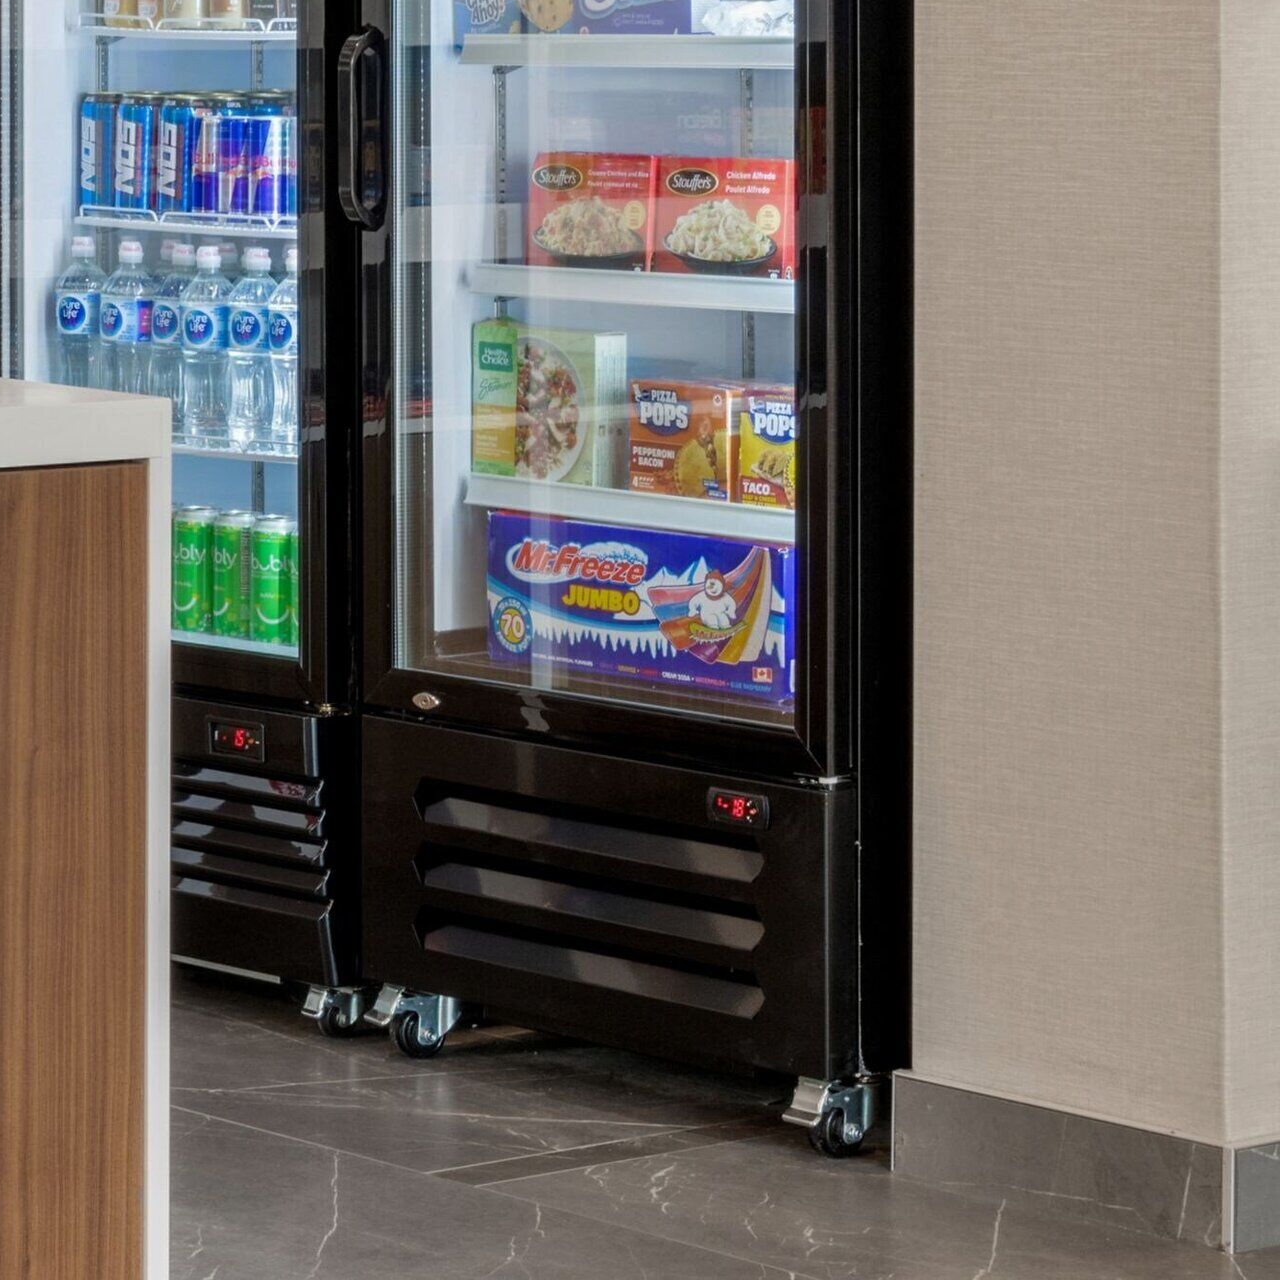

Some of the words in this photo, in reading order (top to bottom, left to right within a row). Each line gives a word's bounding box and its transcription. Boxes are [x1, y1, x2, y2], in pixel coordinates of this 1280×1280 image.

[80, 115, 96, 192] NOS
[115, 119, 137, 195] NOS
[158, 121, 178, 198] NOS
[539, 168, 577, 187] Stouffer's
[671, 173, 712, 192] Stouffer's
[726, 171, 751, 180] Chicken
[752, 171, 776, 181] Alfredo
[725, 185, 746, 194] Poulet
[746, 186, 771, 195] Alfredo
[481, 353, 509, 365] Choice
[651, 389, 678, 403] PIZZA
[640, 401, 689, 430] POPS
[765, 401, 792, 415] PIZZA
[632, 446, 676, 459] PEPPERONI
[638, 457, 664, 469] BACON
[742, 481, 771, 495] TACO
[562, 584, 640, 616] JUMBO
[500, 612, 525, 640] 70
